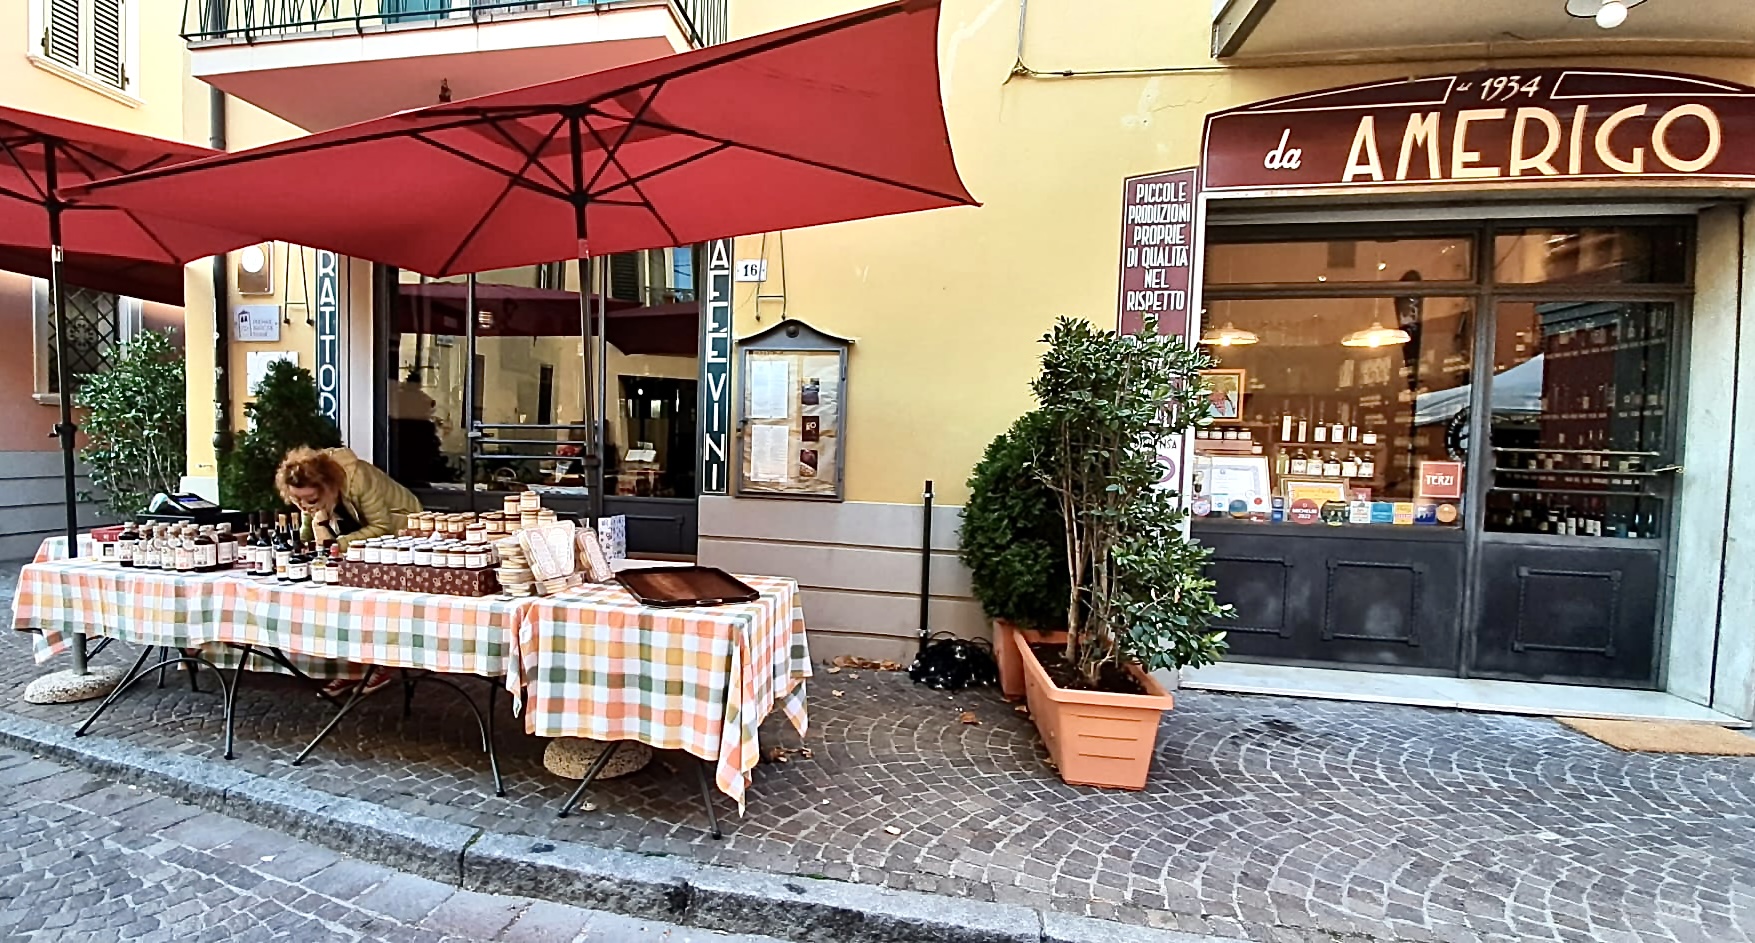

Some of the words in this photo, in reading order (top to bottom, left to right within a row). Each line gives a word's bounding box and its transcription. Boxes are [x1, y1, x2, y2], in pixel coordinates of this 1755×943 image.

[1480, 75, 1542, 101] 1934
[1264, 127, 1302, 171] da
[1341, 103, 1722, 182] AMERIGO
[1135, 182, 1187, 203] PICCOLE
[1128, 203, 1190, 224] PRODUZIONI
[1133, 224, 1186, 245] PROPRIE
[1127, 247, 1138, 267] DI
[743, 263, 758, 277] 16
[1144, 269, 1169, 289] NEL
[1126, 290, 1185, 311] RISPETTO
[318, 250, 336, 419] RATTOR
[705, 372, 726, 490] VINI
[1425, 475, 1454, 486] TERZI
